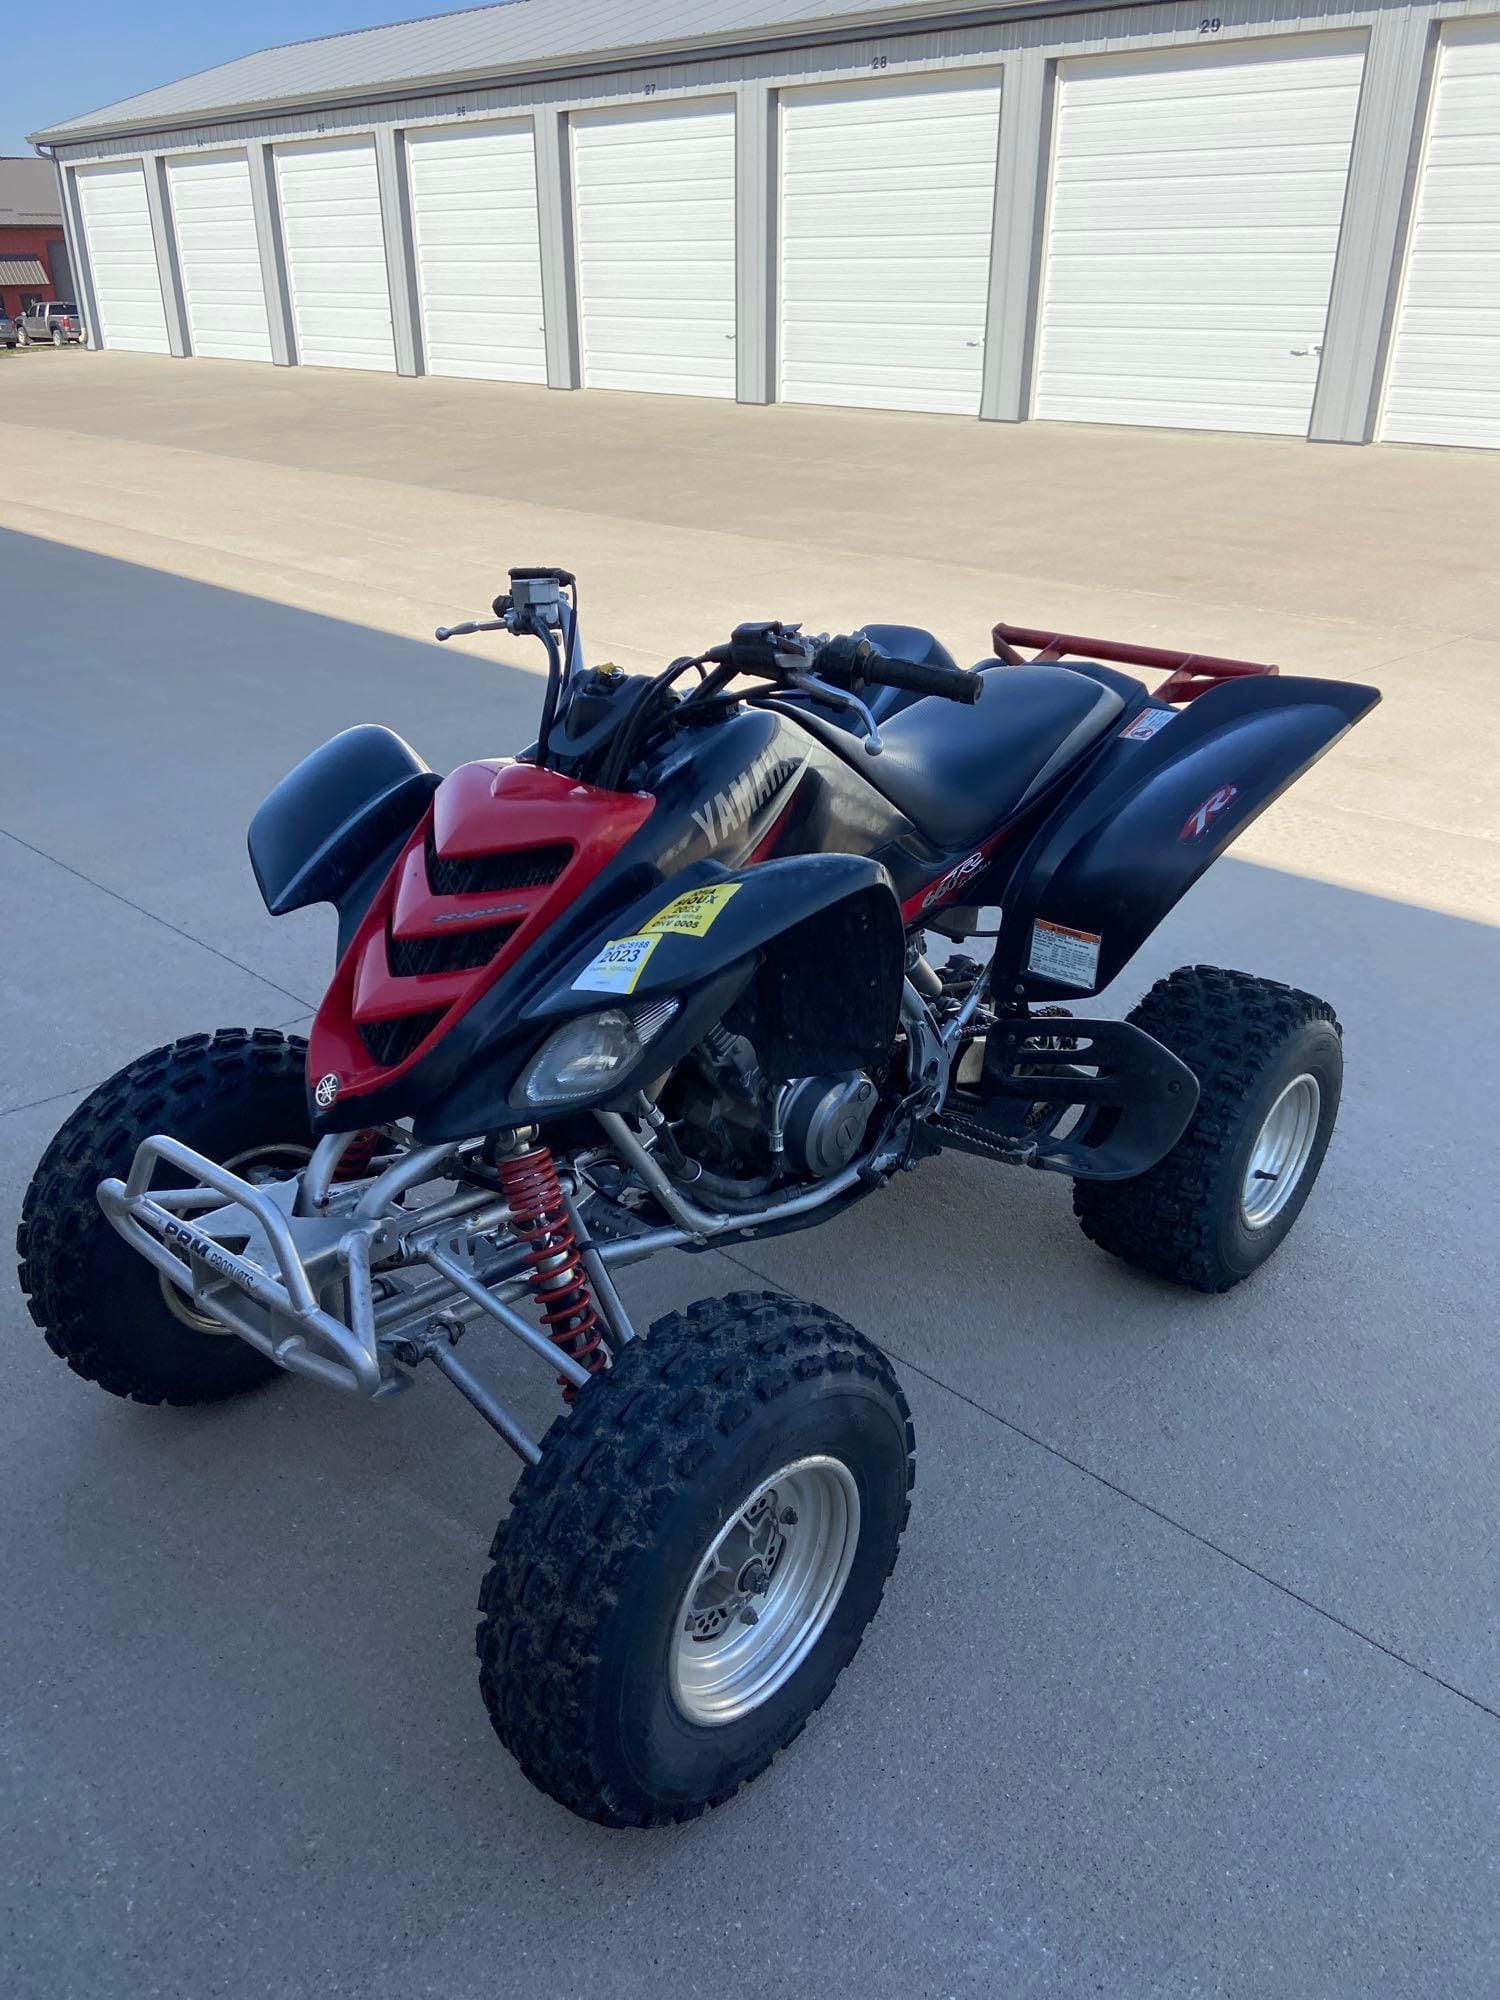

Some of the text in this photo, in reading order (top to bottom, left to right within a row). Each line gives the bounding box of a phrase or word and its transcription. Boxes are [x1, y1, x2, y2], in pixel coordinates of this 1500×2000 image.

[1200, 17, 1221, 34] 29
[872, 55, 888, 70] 28
[644, 84, 656, 96] 27
[674, 920, 700, 929] 0005
[597, 949, 642, 964] 2023
